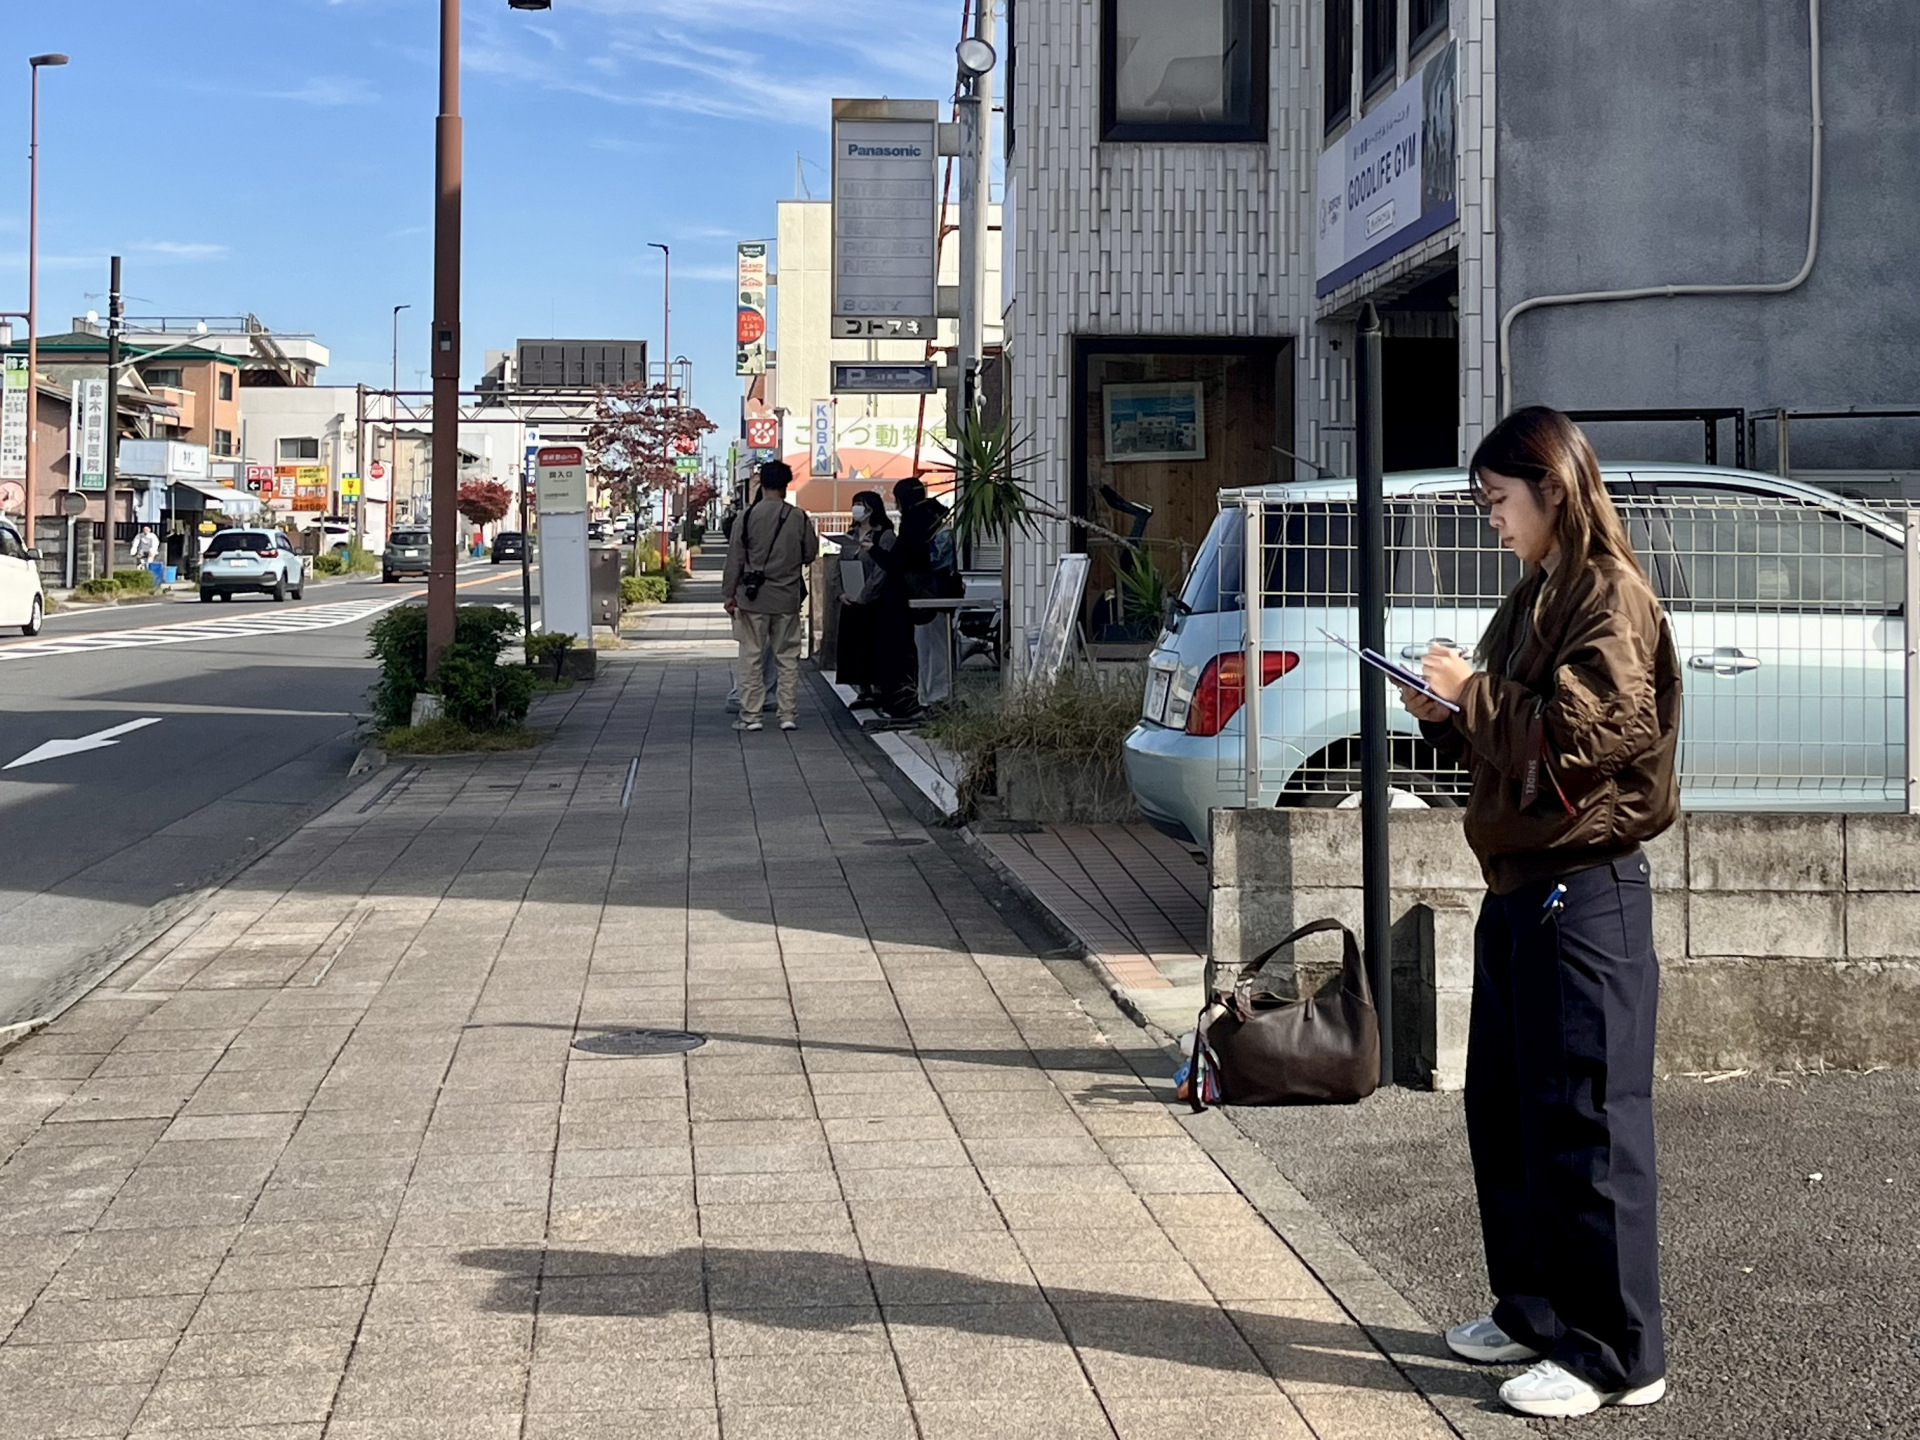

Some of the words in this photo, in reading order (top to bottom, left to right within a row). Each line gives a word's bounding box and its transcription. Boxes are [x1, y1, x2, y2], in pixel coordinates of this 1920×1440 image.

[848, 144, 921, 157] Panasonic
[1348, 150, 1392, 211] GOODLIFE
[1394, 132, 1416, 178] GYM
[843, 299, 903, 312] SONY
[87, 384, 103, 472] 鈴木歯科医院
[815, 404, 828, 472] KOBAN
[249, 468, 260, 480] P
[1526, 759, 1537, 795] SNIDEL
